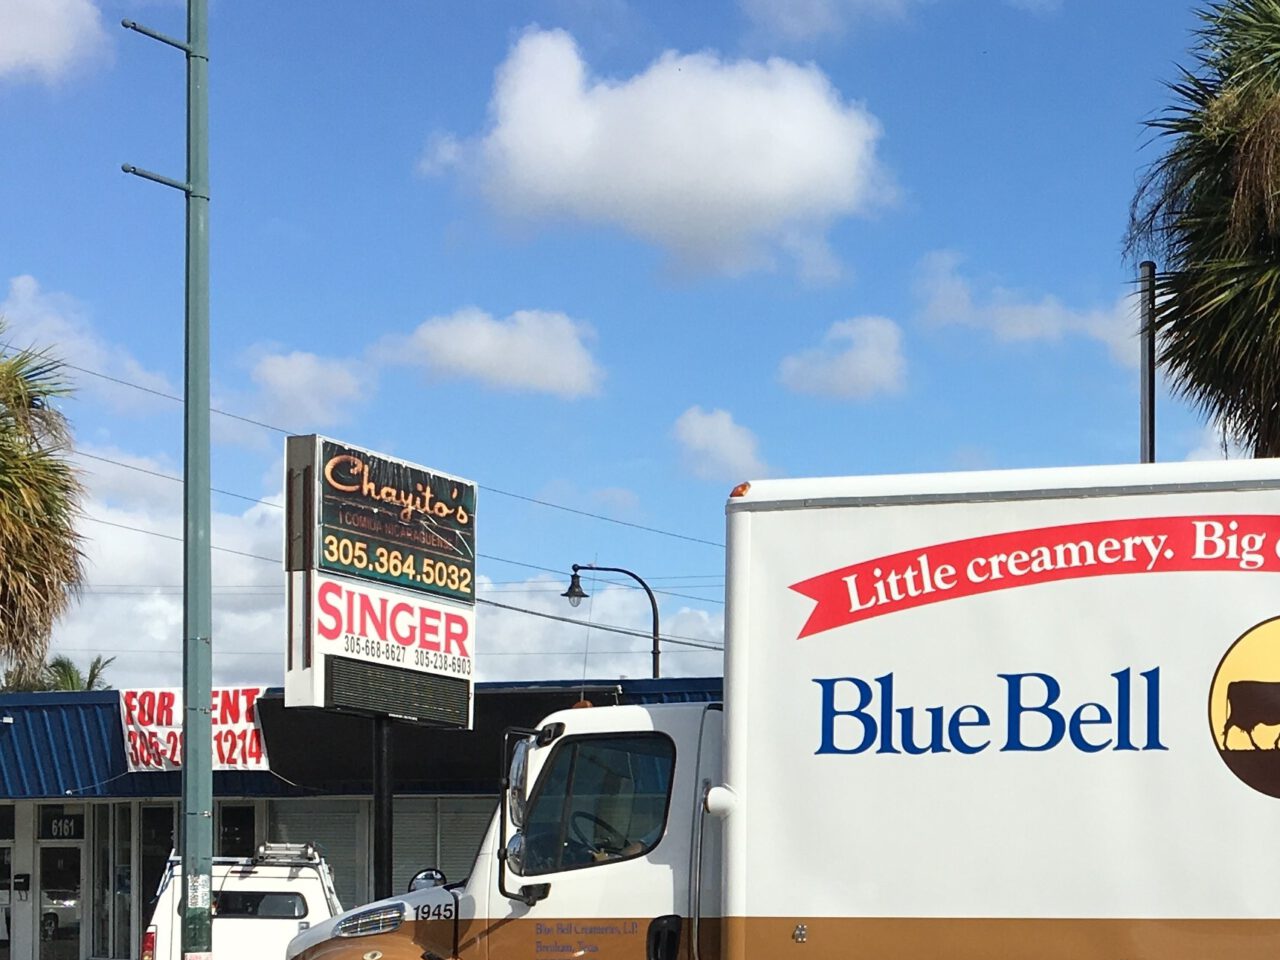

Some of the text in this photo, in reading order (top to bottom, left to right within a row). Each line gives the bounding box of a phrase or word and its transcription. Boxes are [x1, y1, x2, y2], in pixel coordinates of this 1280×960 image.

[325, 454, 469, 525] Chayito's
[324, 534, 472, 594] 305.364.5032
[841, 554, 958, 613] Little
[966, 534, 1175, 583] creamery.
[1191, 520, 1267, 570] Big
[317, 581, 470, 657] SINGER
[344, 635, 472, 676] 305-668-8627 305-238-6903
[124, 691, 175, 726] FOR
[811, 671, 992, 756] Blue
[997, 666, 1170, 753] Bell
[52, 819, 75, 836] 6161
[413, 903, 454, 920] 1945
